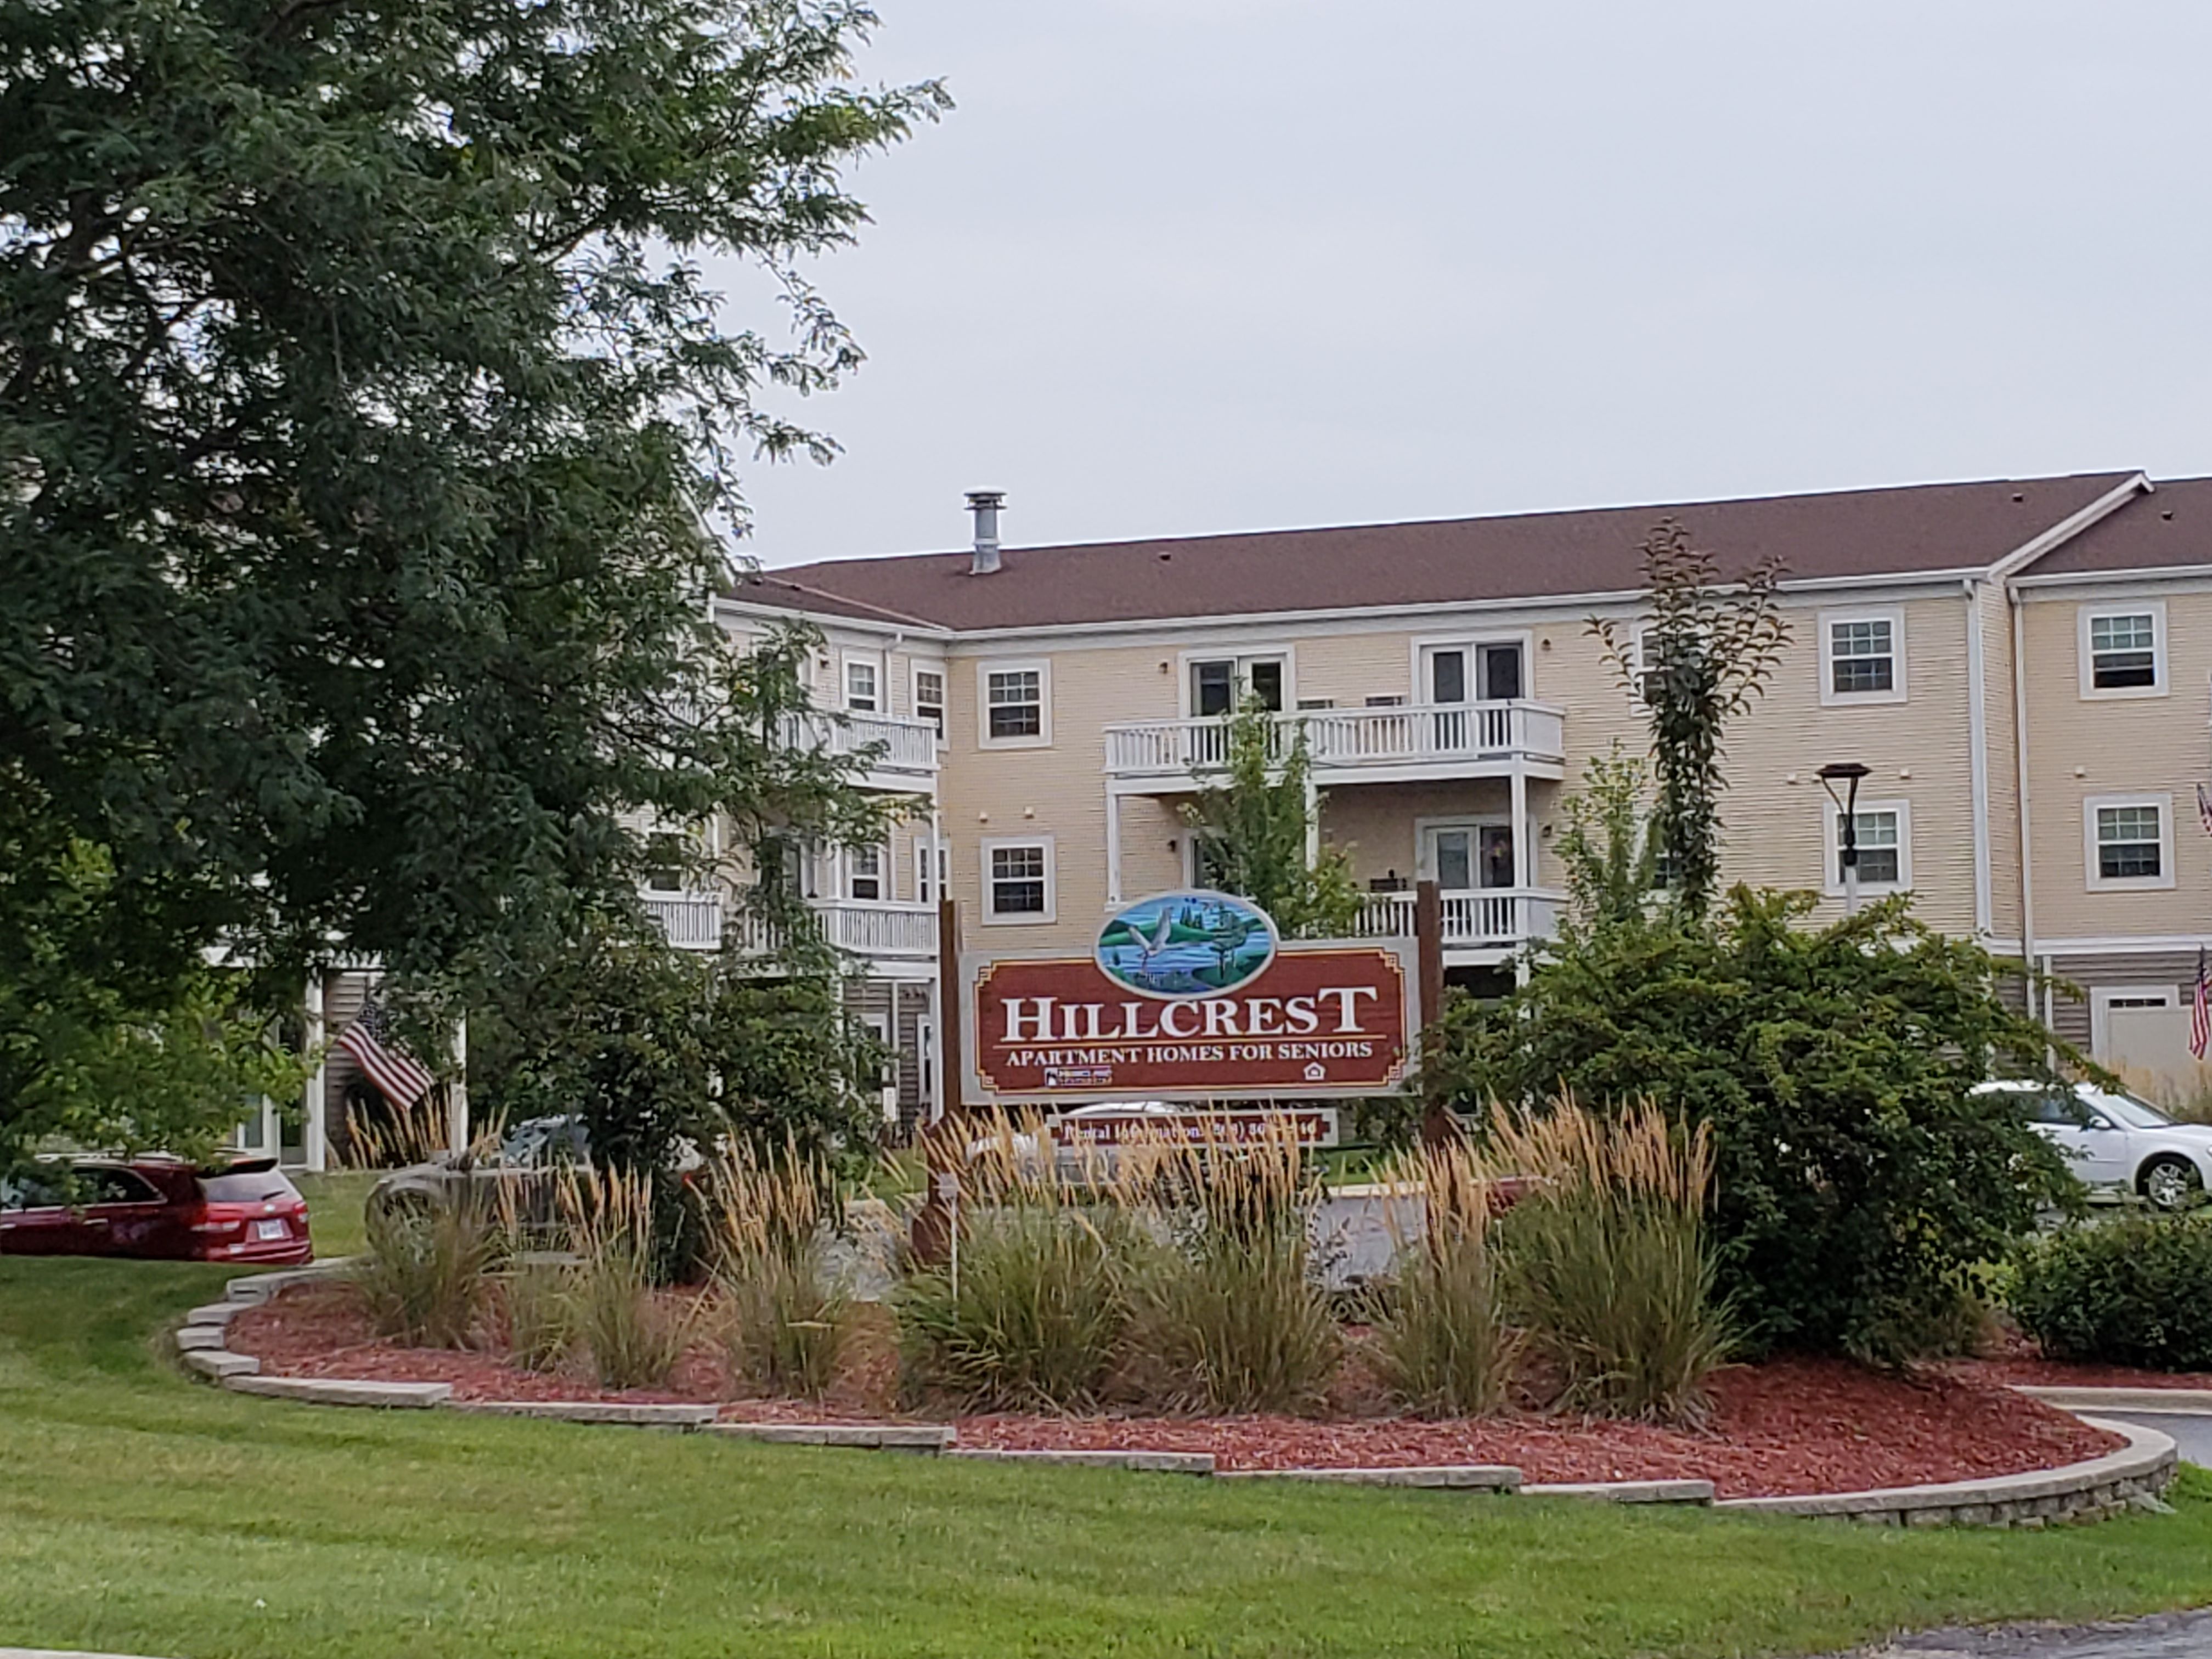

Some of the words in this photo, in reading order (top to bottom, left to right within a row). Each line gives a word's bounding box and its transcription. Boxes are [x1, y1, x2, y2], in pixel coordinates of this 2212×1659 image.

[1000, 986, 1379, 1042] HILLCREST
[1006, 1047, 1142, 1066] APARTMENT
[1147, 1045, 1223, 1063] HOMES
[1229, 1045, 1273, 1061] FOR
[1278, 1042, 1373, 1059] SENIORS
